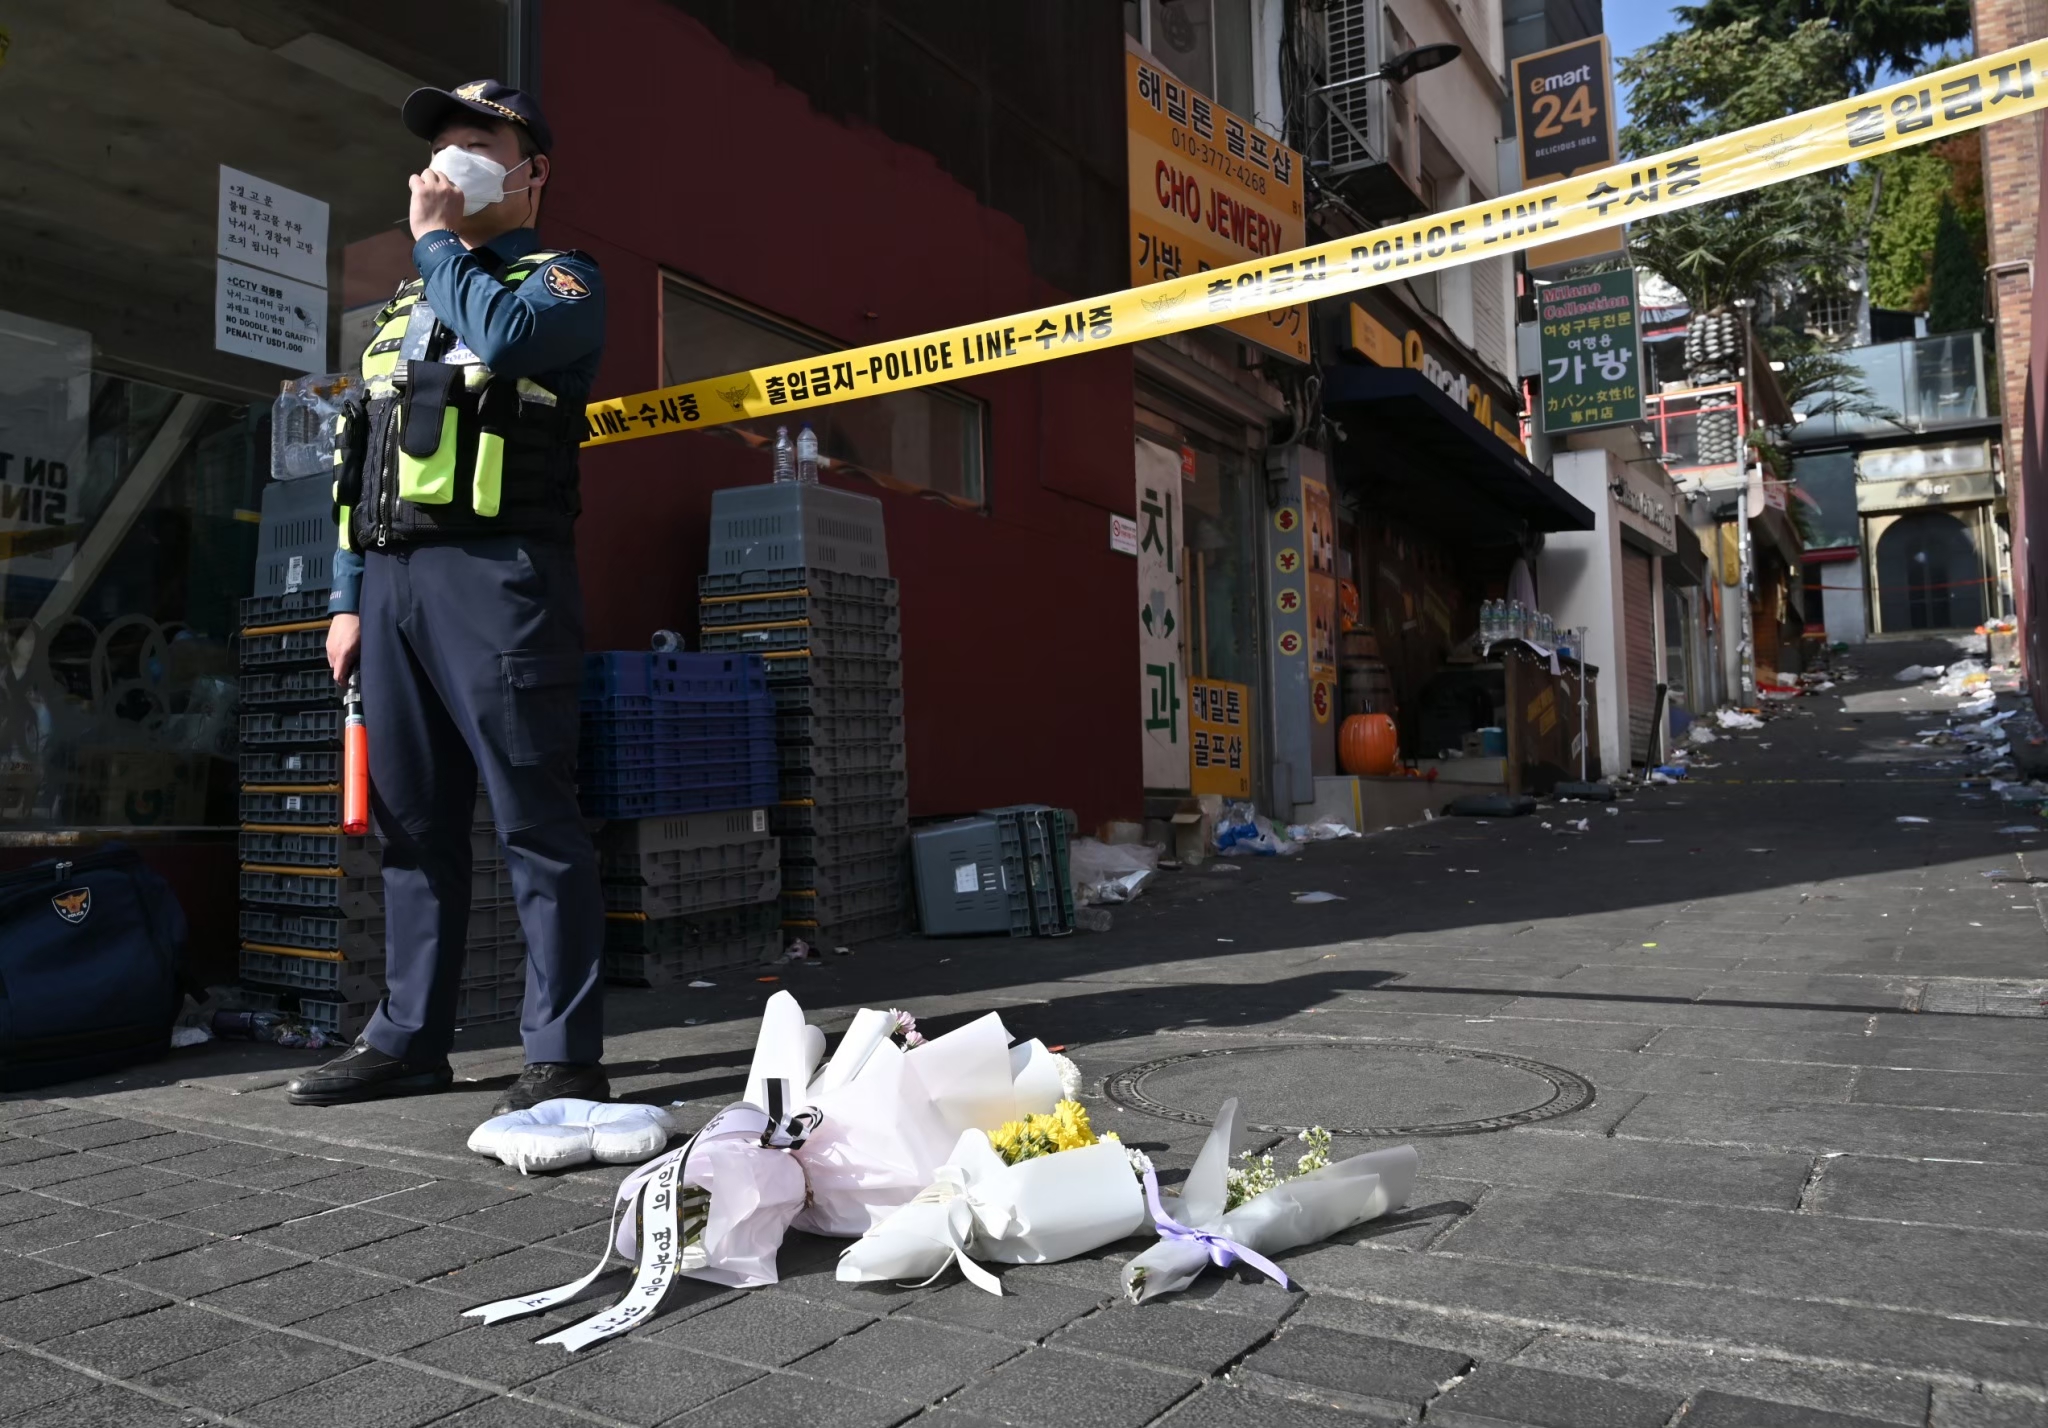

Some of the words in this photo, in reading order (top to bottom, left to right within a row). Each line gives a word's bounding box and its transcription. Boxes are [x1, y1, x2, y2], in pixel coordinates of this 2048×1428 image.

[1530, 64, 1591, 94] emart
[1532, 84, 1598, 138] 24
[1846, 58, 2035, 148] 출입금지
[1137, 66, 1213, 140] 해밀톤
[1225, 117, 1292, 186] 골프샵
[1171, 127, 1266, 195] 010-3772-4268
[1535, 140, 1576, 157] DELICIOUS
[1578, 136, 1597, 147] IDEA
[1155, 159, 1201, 223] CHO
[1206, 188, 1281, 255] JEWERY
[1351, 219, 1466, 273] POLICE
[1482, 195, 1559, 244] LINE
[1586, 156, 1702, 216] 수사중
[1138, 232, 1182, 280] 가방
[1542, 282, 1601, 303] Milano
[1544, 295, 1629, 320] Collection
[226, 315, 237, 323] NO
[272, 327, 282, 336] NO
[285, 331, 316, 345] GRAFFITI
[226, 326, 263, 343] PENALTY
[1544, 312, 1631, 337] 여성구두전문
[1567, 333, 1612, 350] 여행용
[1547, 347, 1632, 385] 가방
[1192, 686, 1240, 723] 해밀톤
[1194, 732, 1241, 769] 골프샵
[641, 1227, 673, 1296] 명복을
